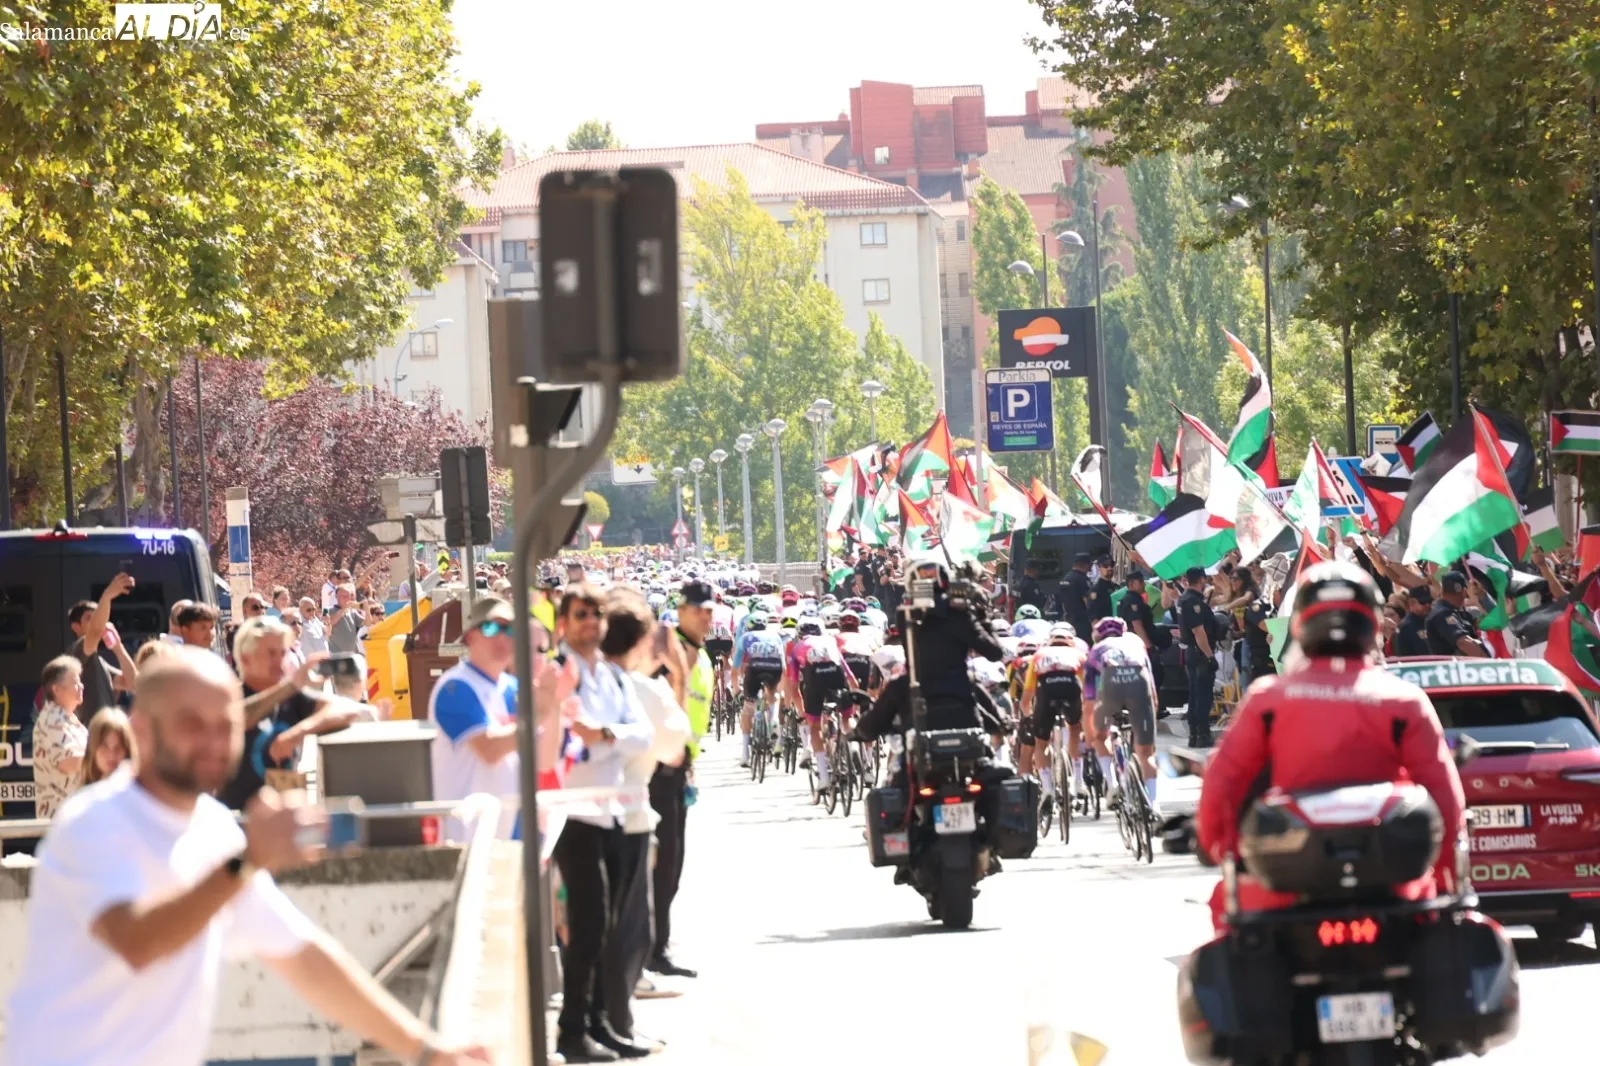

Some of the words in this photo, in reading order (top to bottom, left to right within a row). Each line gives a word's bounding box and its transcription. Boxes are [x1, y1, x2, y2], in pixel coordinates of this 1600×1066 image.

[999, 370, 1036, 382] Parkia
[1007, 388, 1031, 418] P
[141, 540, 175, 555] 7U-16
[1497, 808, 1517, 825] HM
[1540, 804, 1551, 816] LA
[1551, 803, 1583, 816] VUELTA
[1479, 834, 1537, 852] COMISARIOS
